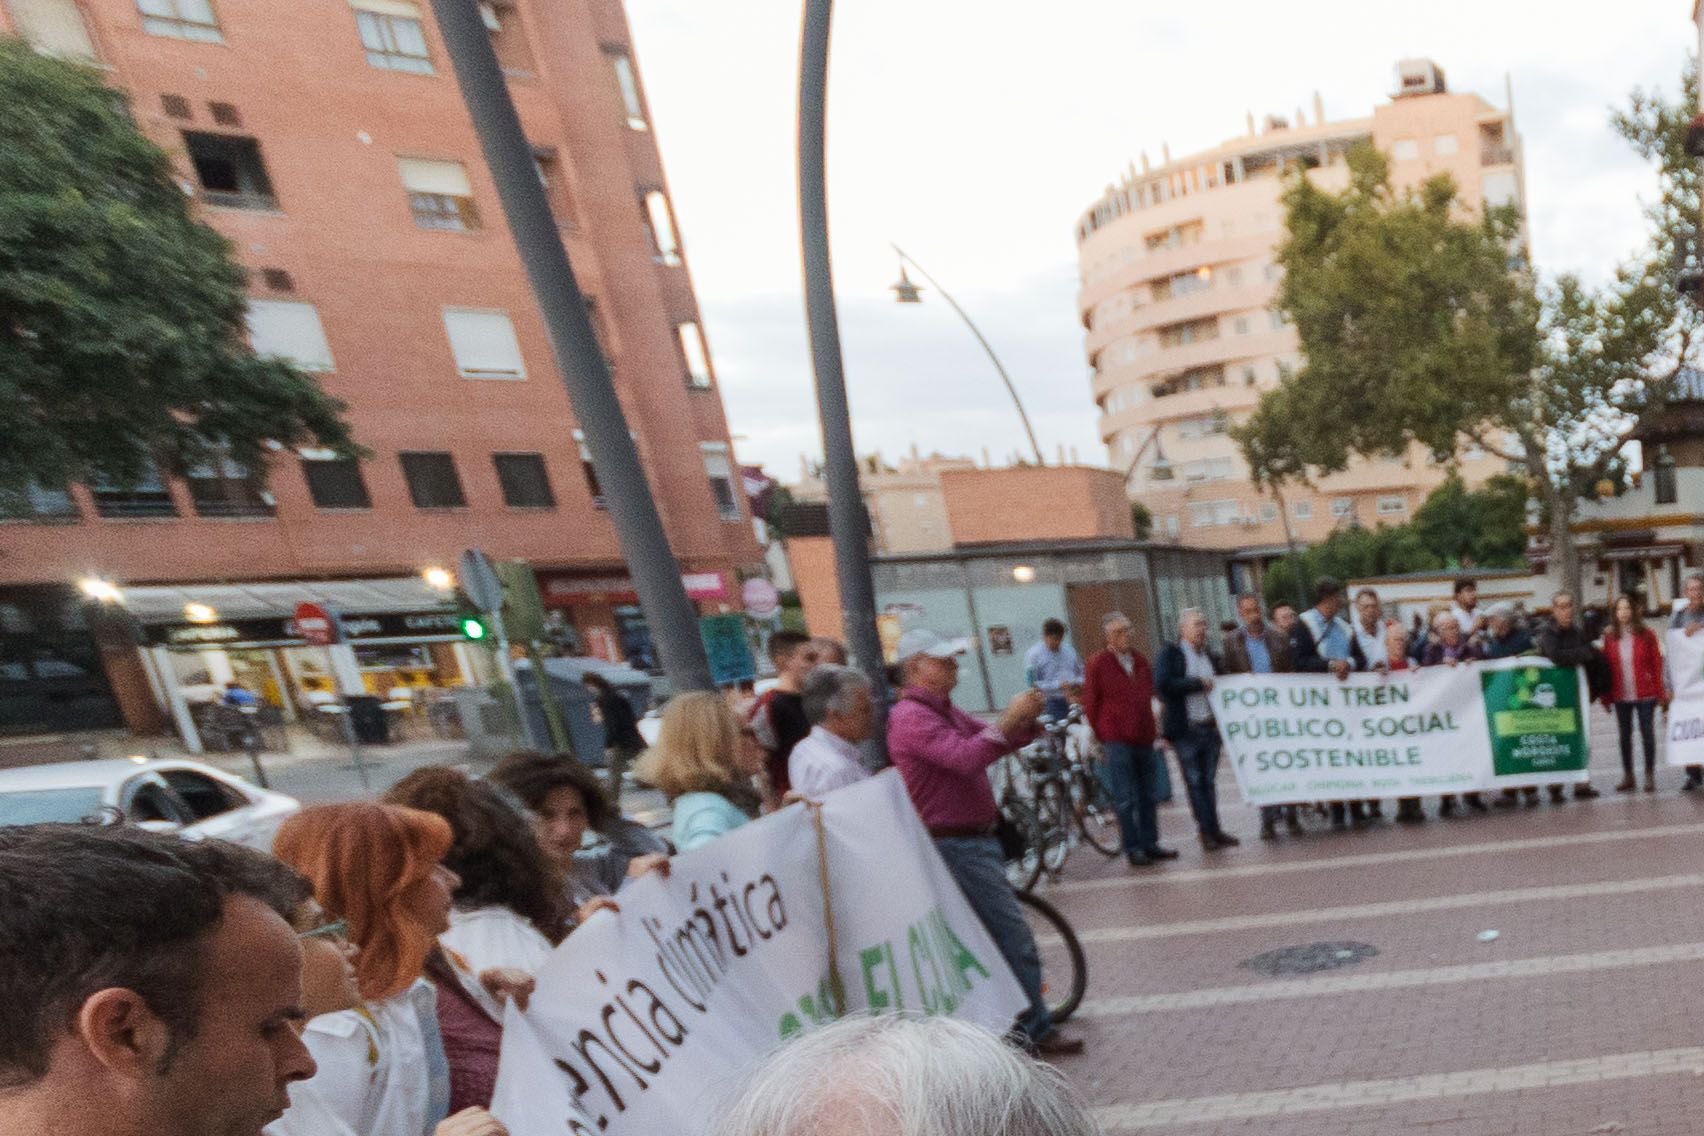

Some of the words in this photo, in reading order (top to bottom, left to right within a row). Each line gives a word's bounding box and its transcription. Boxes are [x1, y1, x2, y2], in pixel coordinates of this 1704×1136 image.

[1222, 687, 1279, 709] POR
[1288, 686, 1330, 707] UN
[1338, 683, 1410, 706] TREN
[1361, 710, 1460, 738] SOCIAL
[1256, 746, 1422, 771] SOSTENIBLE
